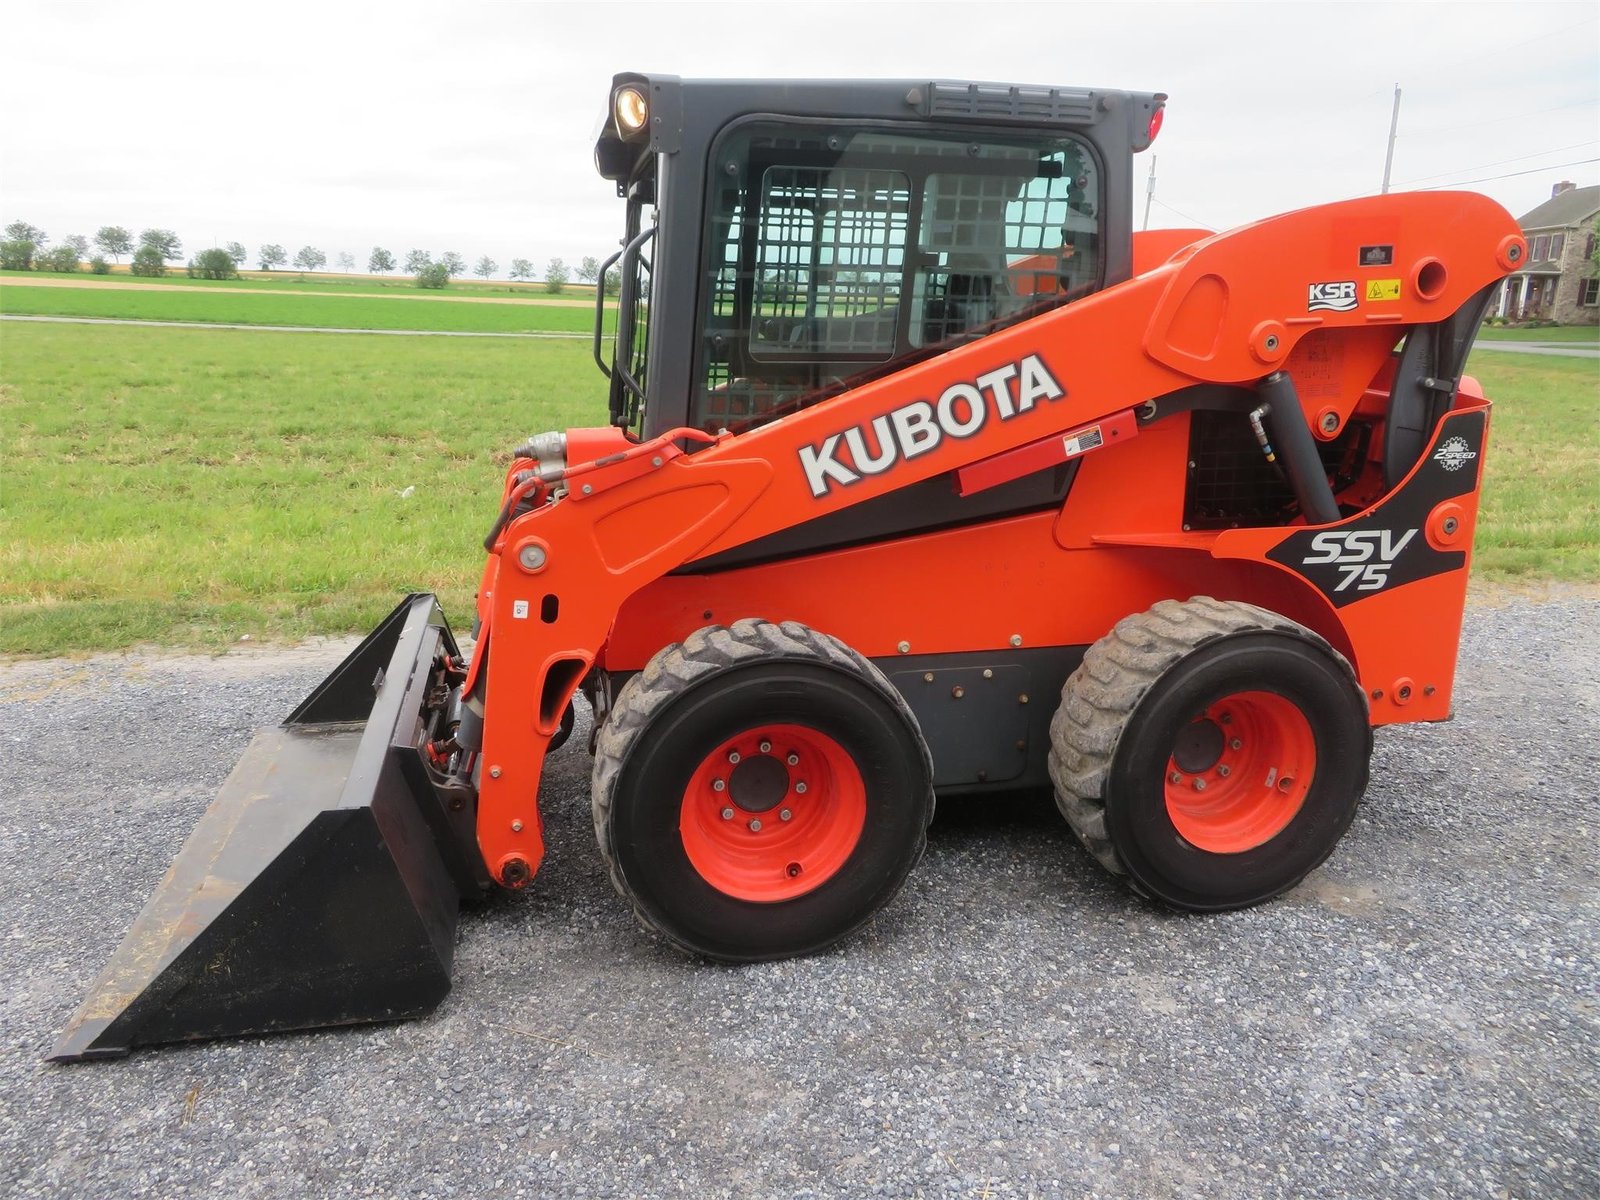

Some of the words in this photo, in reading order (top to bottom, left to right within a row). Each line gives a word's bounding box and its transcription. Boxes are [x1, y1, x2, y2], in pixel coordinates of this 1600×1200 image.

[1309, 282, 1356, 300] KSR
[798, 354, 1064, 498] KUBOTA
[1302, 529, 1419, 564] SSV
[1333, 564, 1392, 592] 75
